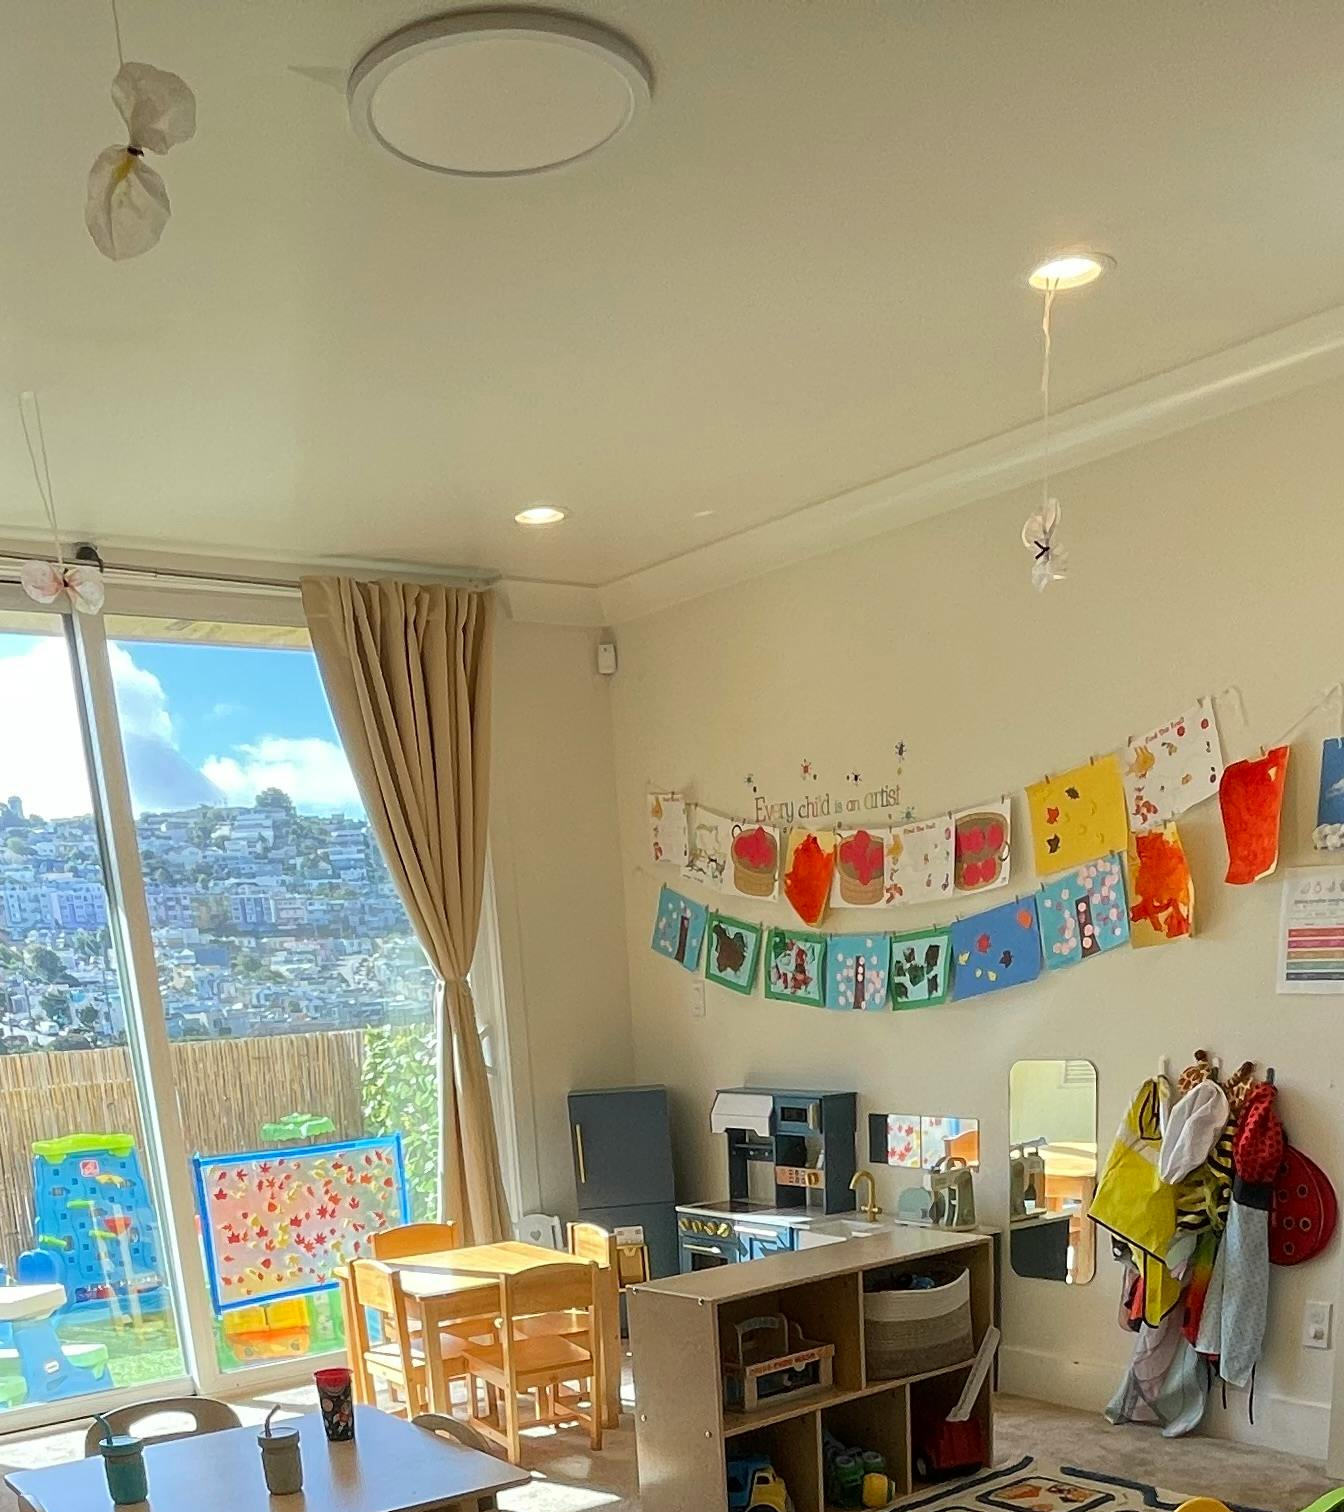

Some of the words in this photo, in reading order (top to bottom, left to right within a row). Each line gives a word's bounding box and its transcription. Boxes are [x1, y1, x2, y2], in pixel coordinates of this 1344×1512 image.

[754, 796, 794, 823] Every
[797, 793, 831, 819] child
[834, 800, 843, 814] is
[846, 798, 861, 812] an
[864, 784, 902, 810] artist
